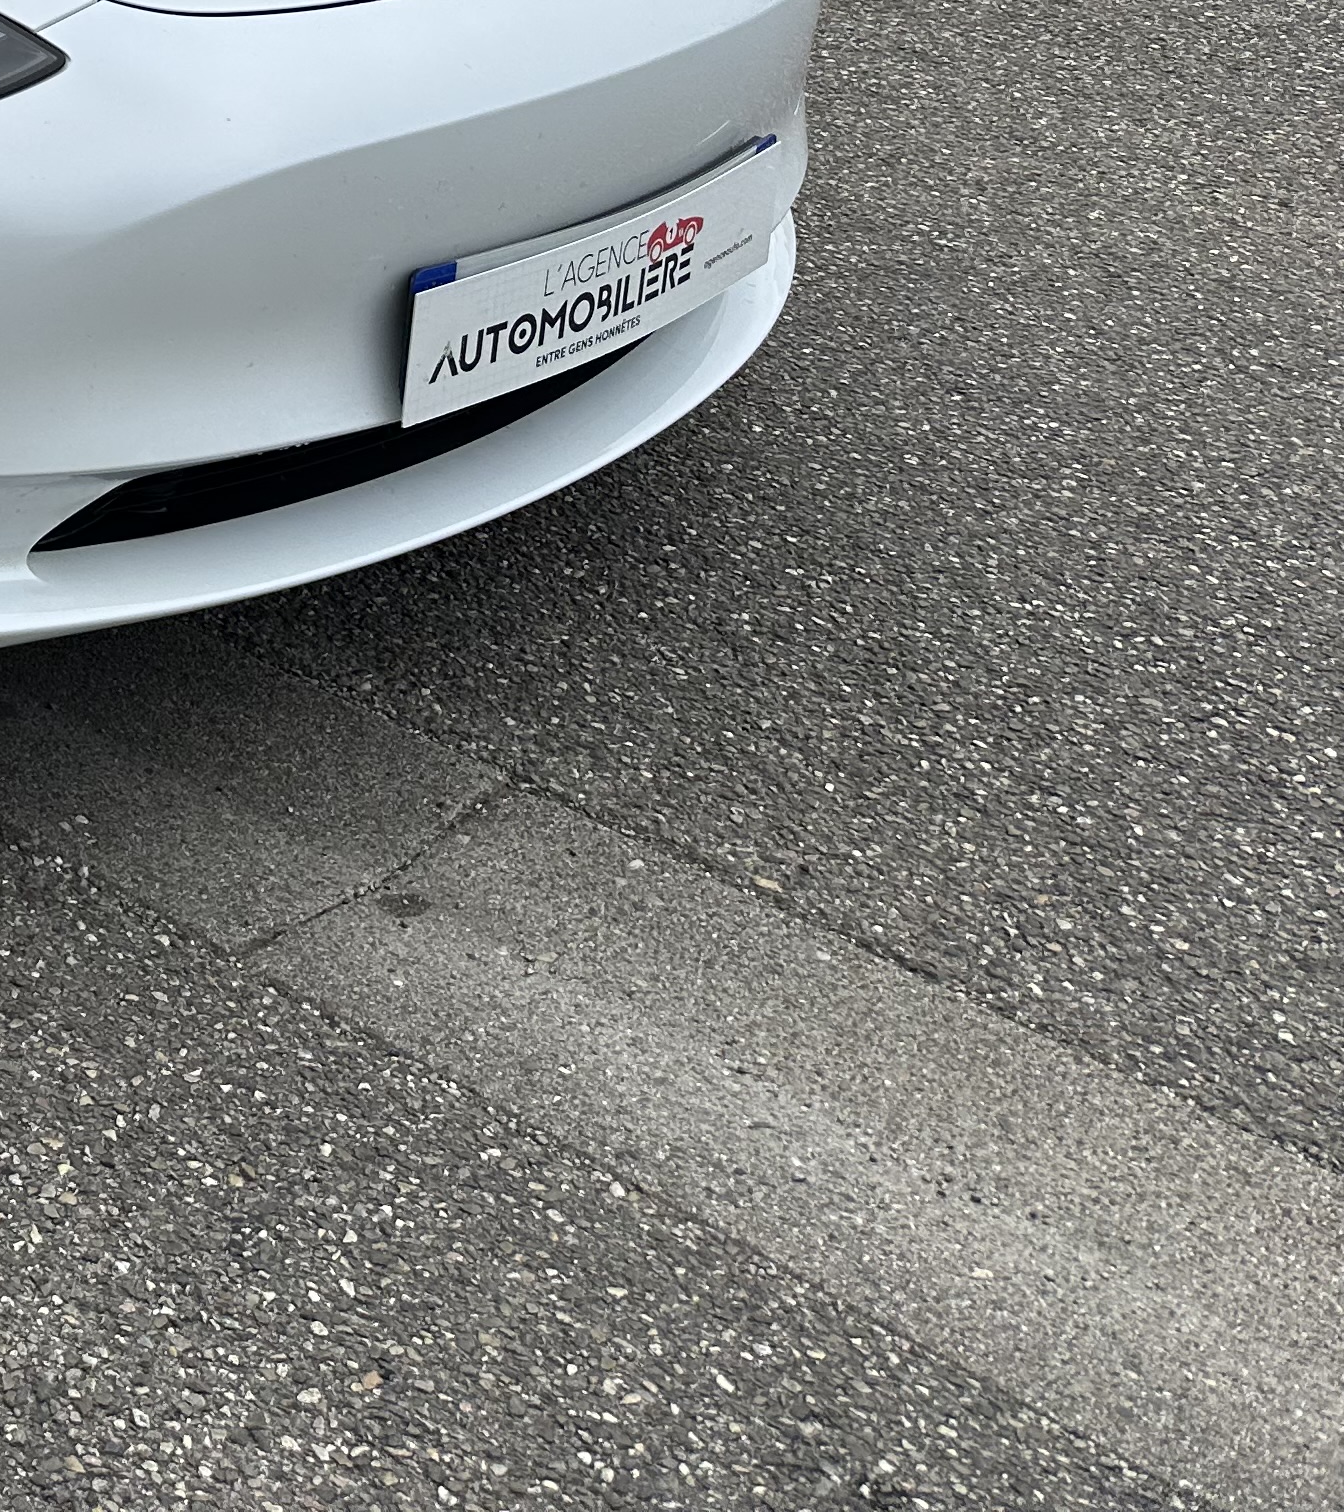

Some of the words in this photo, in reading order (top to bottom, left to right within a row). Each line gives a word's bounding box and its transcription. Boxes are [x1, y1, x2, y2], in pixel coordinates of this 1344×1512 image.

[542, 229, 651, 297] L'AGENCE
[535, 346, 567, 368] ENTRE
[568, 335, 593, 355] GENS
[595, 314, 641, 345] HONNÊTES
